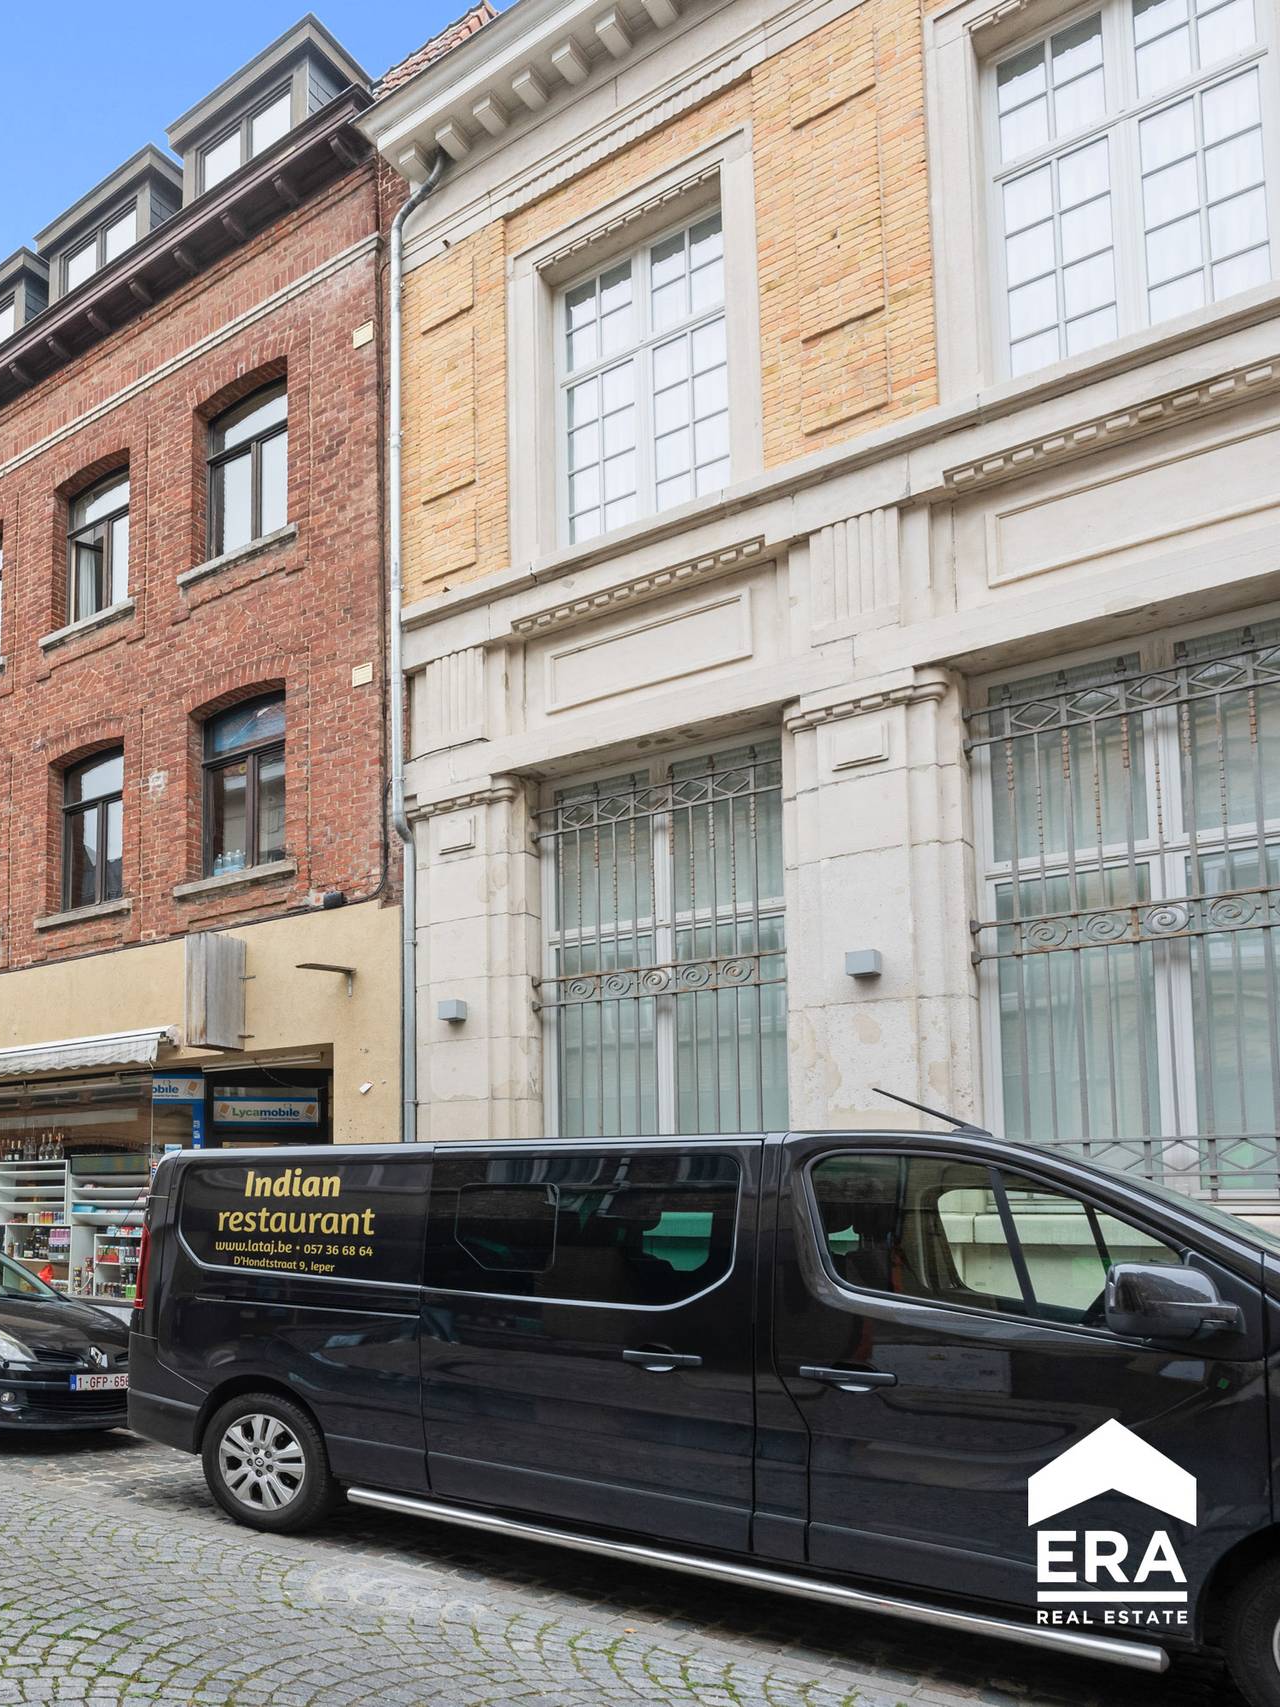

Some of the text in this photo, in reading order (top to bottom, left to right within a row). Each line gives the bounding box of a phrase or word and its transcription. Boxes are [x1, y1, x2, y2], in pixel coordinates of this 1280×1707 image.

[232, 1106, 300, 1118] Lycamobile
[243, 1167, 342, 1198] Indian
[217, 1207, 376, 1236] restaurant
[215, 1239, 374, 1257] www.lataj.be 057 36 68 64
[233, 1255, 336, 1274] D'Hondtstraat 9, Ieper
